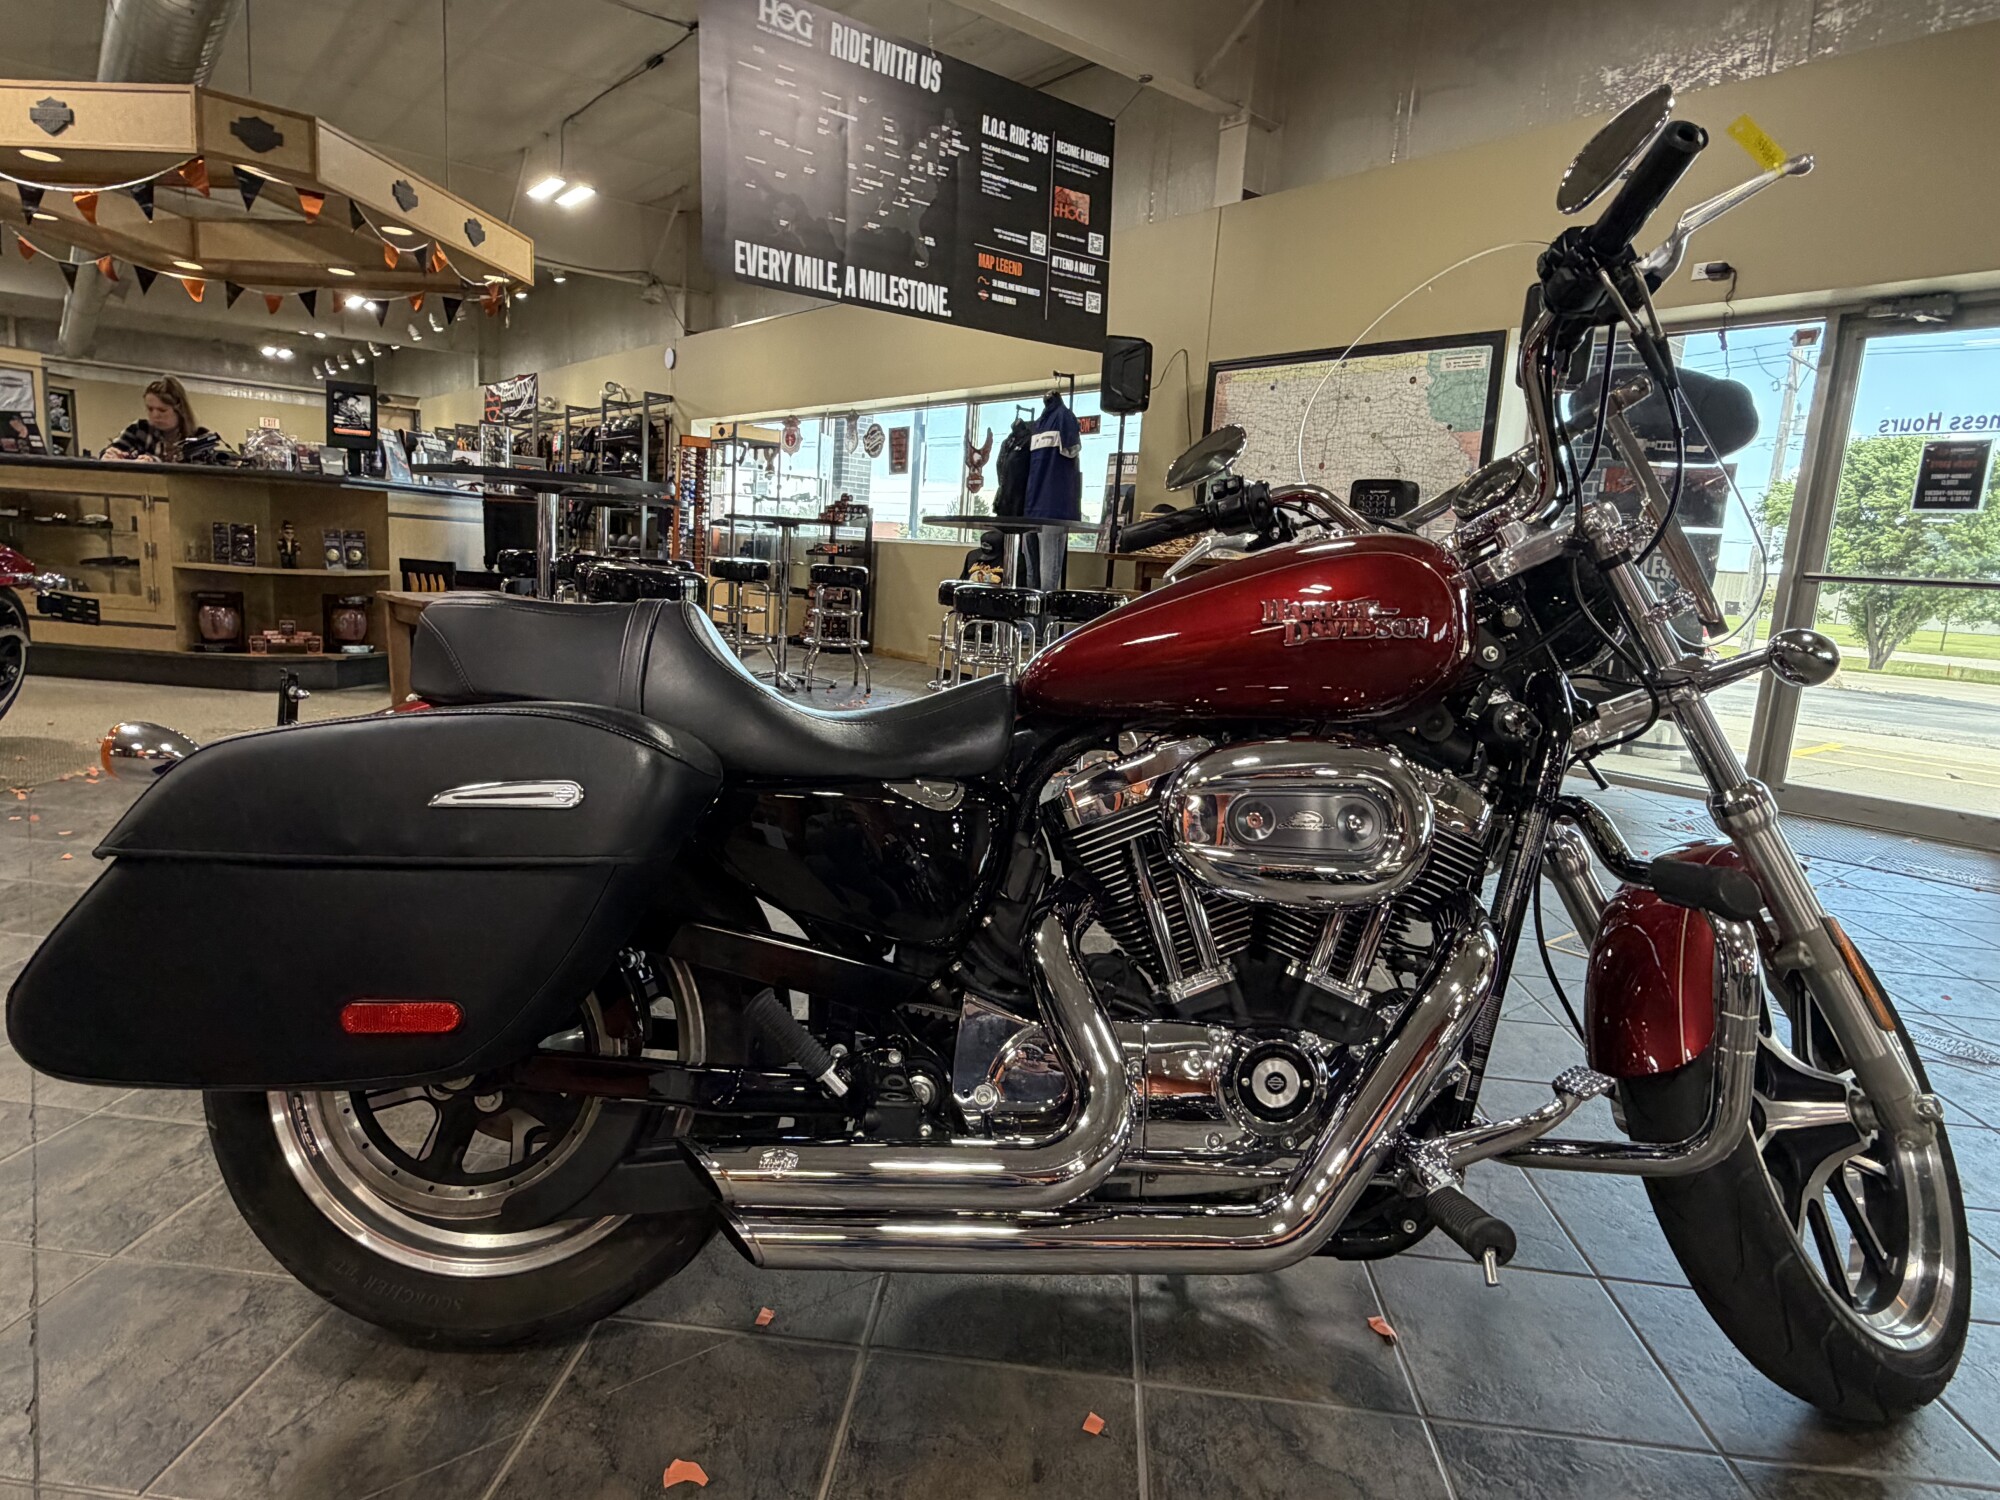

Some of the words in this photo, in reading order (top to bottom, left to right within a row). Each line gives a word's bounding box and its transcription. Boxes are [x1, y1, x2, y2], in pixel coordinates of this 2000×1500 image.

[757, 0, 814, 40] HOG
[830, 21, 872, 69] RIDE
[873, 37, 918, 85] WITH
[919, 55, 943, 93] US
[982, 114, 1008, 141] H.O.G.
[1009, 123, 1031, 149] RIDE
[1031, 131, 1049, 155] 365
[1056, 139, 1079, 160] BECOME
[1079, 148, 1085, 161] A
[1085, 149, 1110, 169] MEMBER
[735, 239, 793, 284] EVERY
[794, 253, 843, 299] MILE,
[844, 265, 857, 298] A
[859, 268, 953, 318] MILESTONE.
[978, 252, 995, 270] MAP
[995, 256, 1023, 277] LEGEND
[1051, 255, 1074, 273] ATTEND
[1074, 260, 1079, 273] A
[1079, 261, 1097, 277] RALLY
[263, 417, 276, 428] EXIT
[1283, 616, 1430, 647] DAVIDSON
